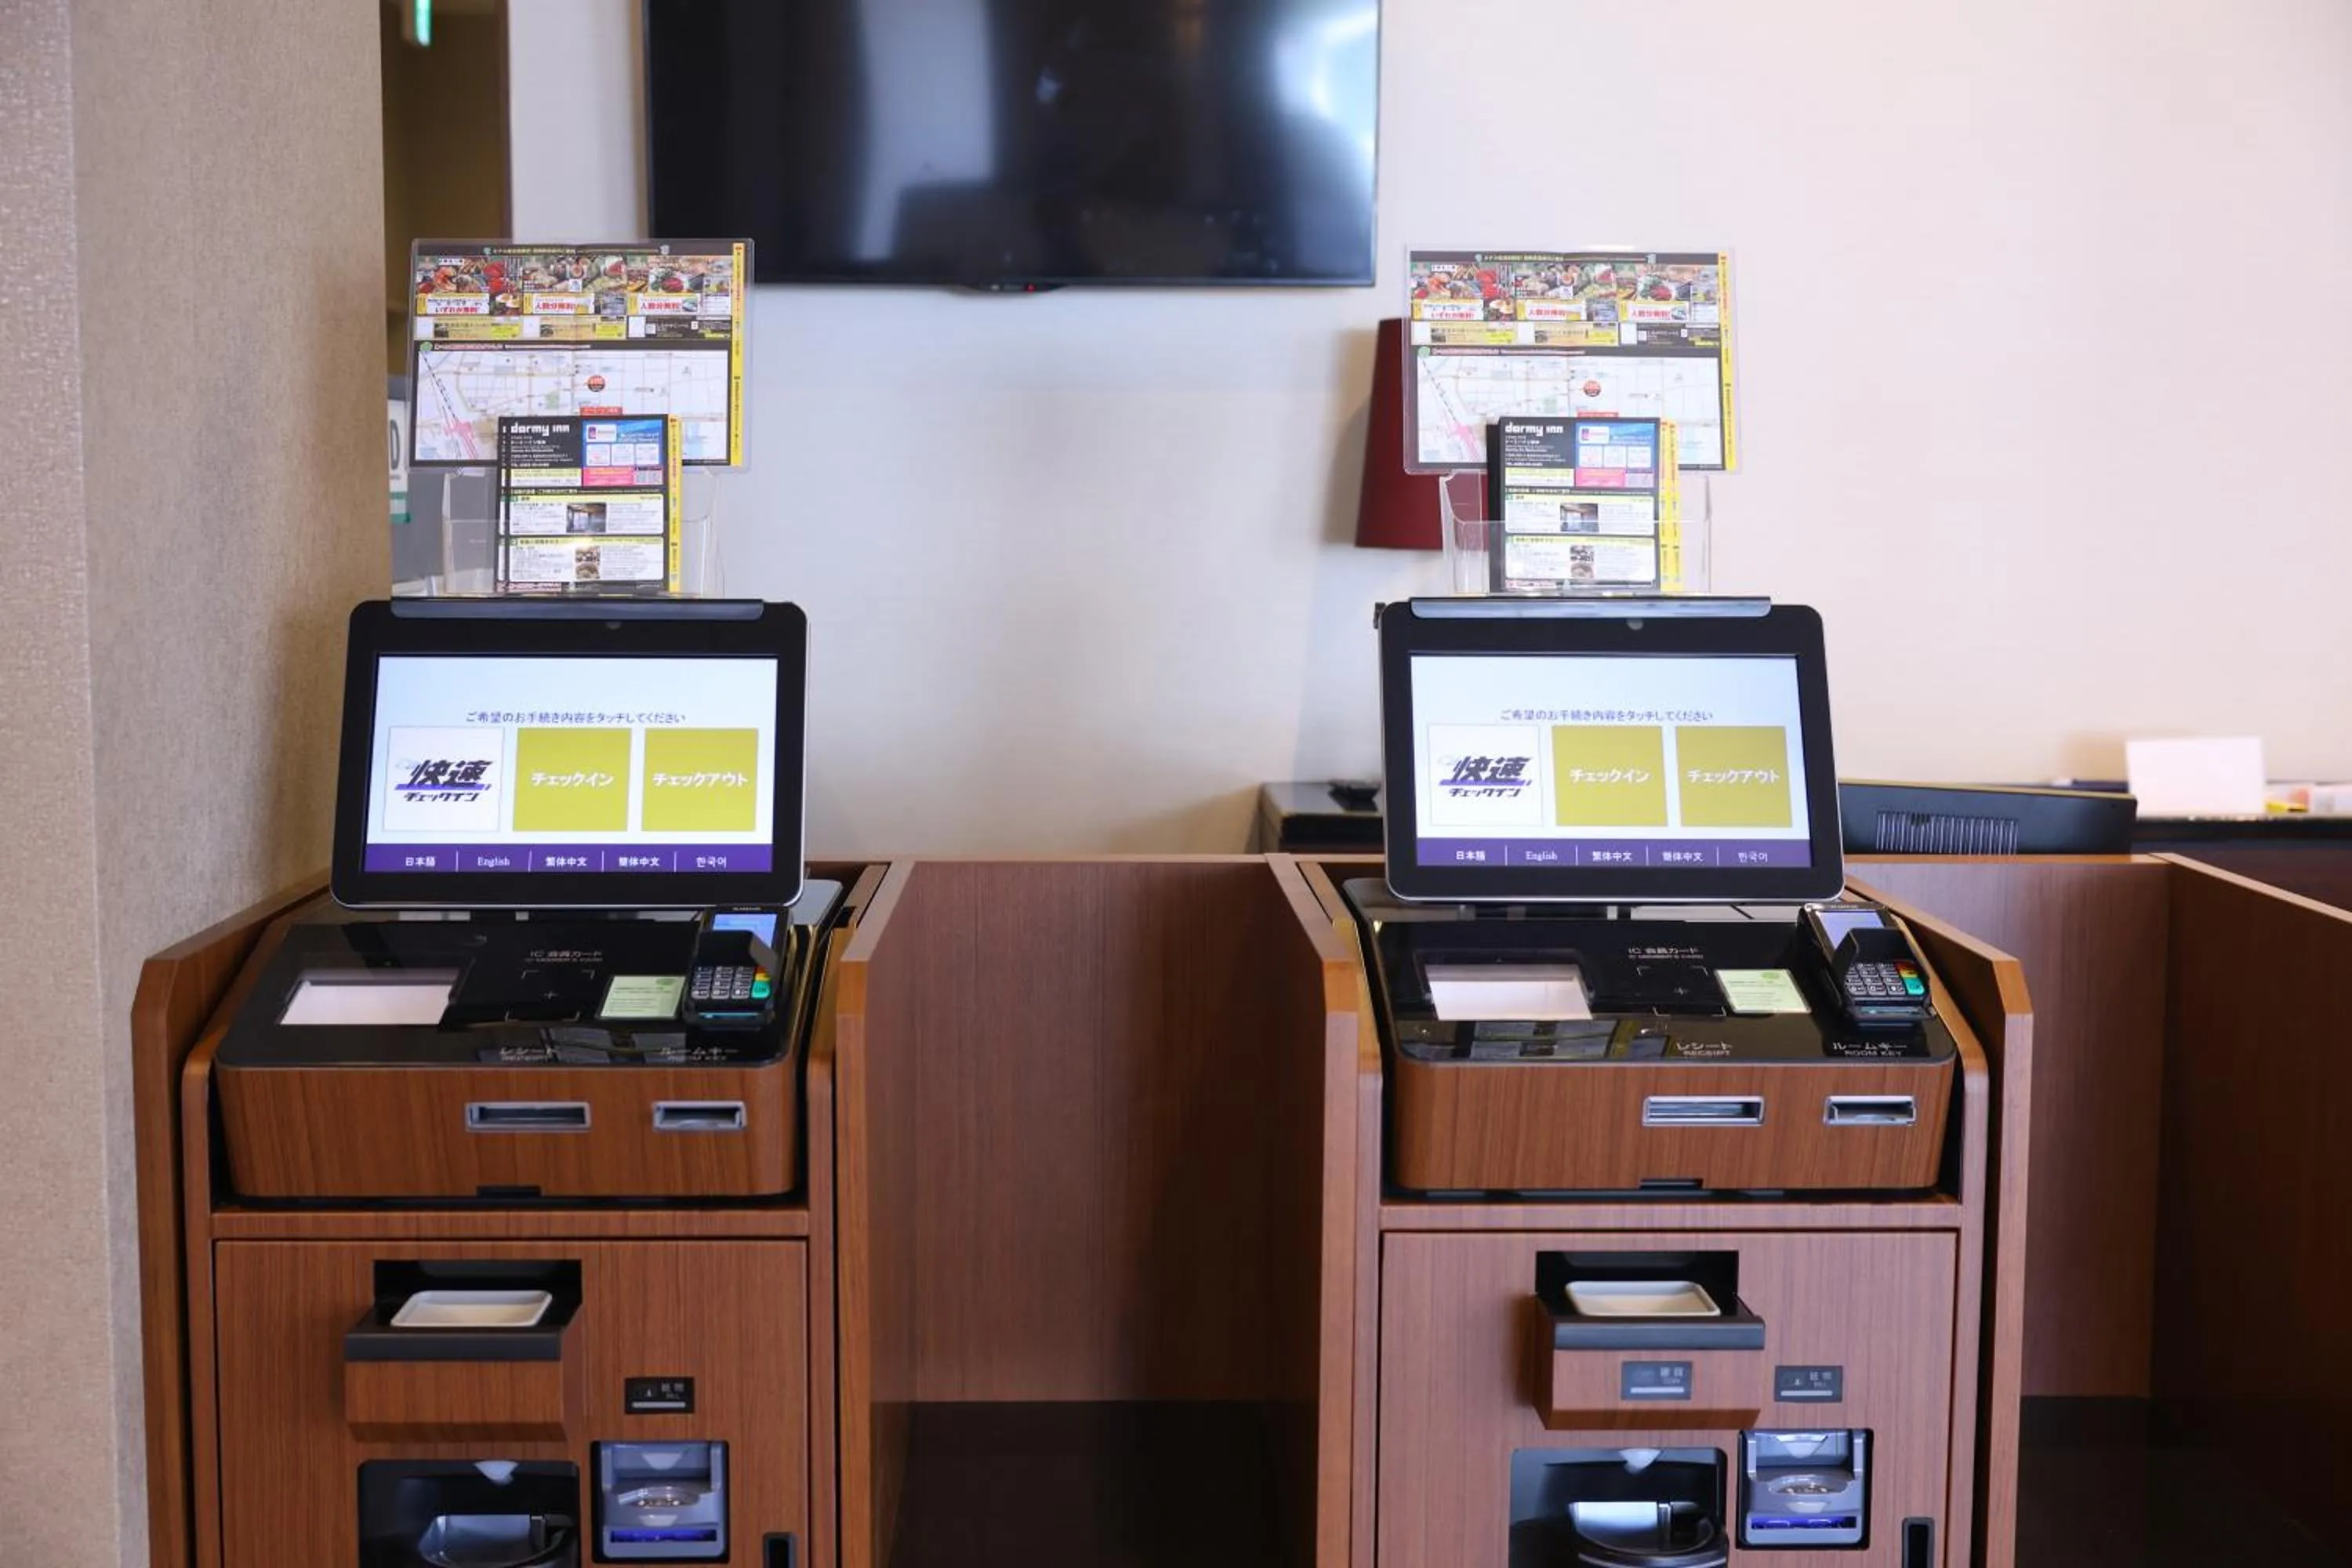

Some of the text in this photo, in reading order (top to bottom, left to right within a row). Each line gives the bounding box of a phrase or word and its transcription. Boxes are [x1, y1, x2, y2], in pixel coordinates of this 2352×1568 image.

[510, 422, 570, 437] dormy inn
[1504, 421, 1564, 437] dormy inn
[466, 712, 686, 724] ご希望のお手続き内容をタッチしてください
[1500, 709, 1714, 722] ご希望のお手続き内容をタッチしてください
[408, 760, 492, 787] 快速
[1452, 756, 1532, 782] 快速
[531, 771, 615, 787] チェックイン
[652, 771, 749, 787] チェックアウト
[1569, 768, 1650, 783] チェックイン
[1687, 769, 1780, 784] チェックアウト
[404, 792, 480, 802] チェックイン
[1448, 788, 1521, 797] チェックイン
[405, 856, 436, 867] 日本語
[477, 856, 510, 868] English
[696, 856, 728, 868] 한국어
[1456, 851, 1486, 861] 日本語
[1525, 851, 1558, 862] English
[1737, 851, 1769, 862] 한국어
